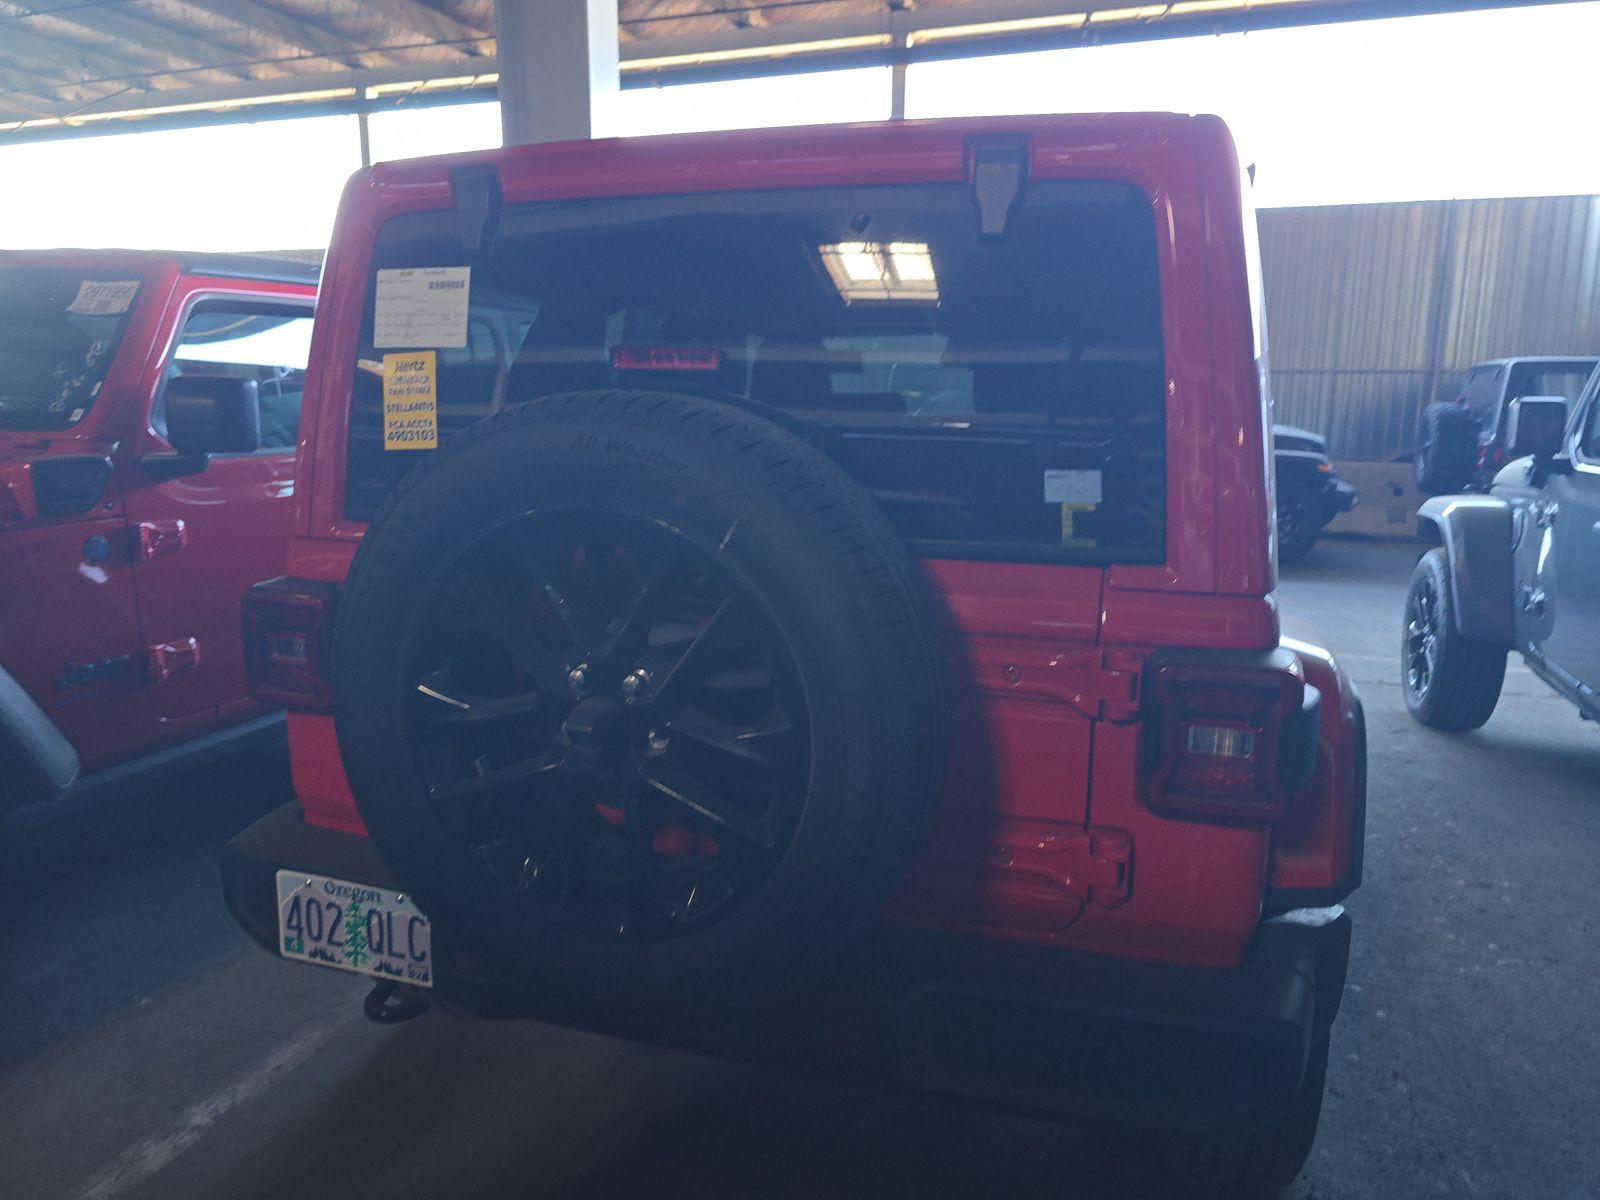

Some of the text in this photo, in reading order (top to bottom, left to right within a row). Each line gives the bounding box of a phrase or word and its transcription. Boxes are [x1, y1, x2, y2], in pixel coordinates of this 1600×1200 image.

[394, 360, 425, 375] Hertz
[387, 429, 435, 442] 4903103
[324, 880, 381, 904] Oregon
[286, 895, 427, 962] 402 QLC
